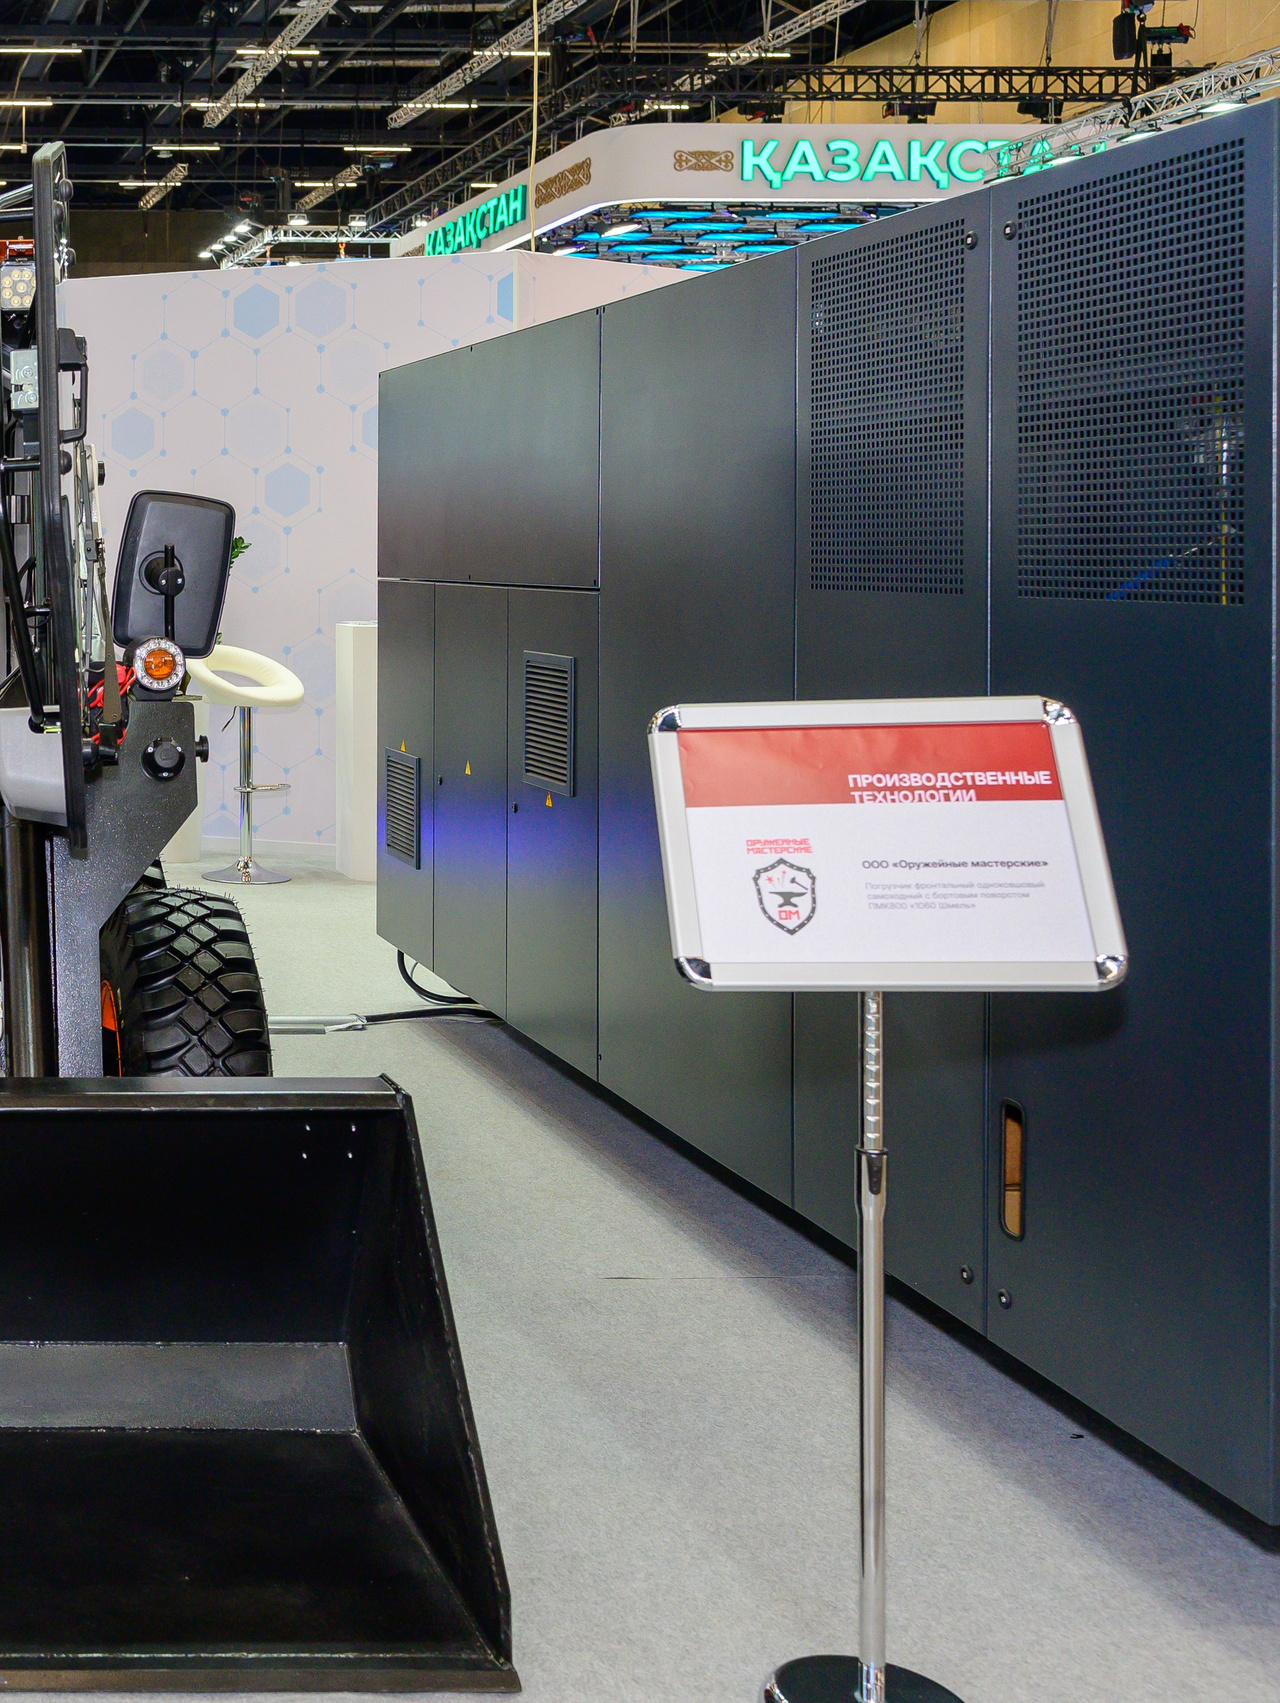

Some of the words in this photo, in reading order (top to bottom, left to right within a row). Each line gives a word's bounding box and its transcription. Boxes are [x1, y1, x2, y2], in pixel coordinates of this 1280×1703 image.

[847, 771, 1053, 788] ПРОИЗВОДСТВЕННЫЕ
[850, 789, 977, 804] ТЕХНОЛОГИИ
[862, 860, 889, 869] ООО
[892, 859, 968, 871] «Оружейные
[971, 860, 1049, 870] мастерские»
[778, 909, 800, 921] ОМ
